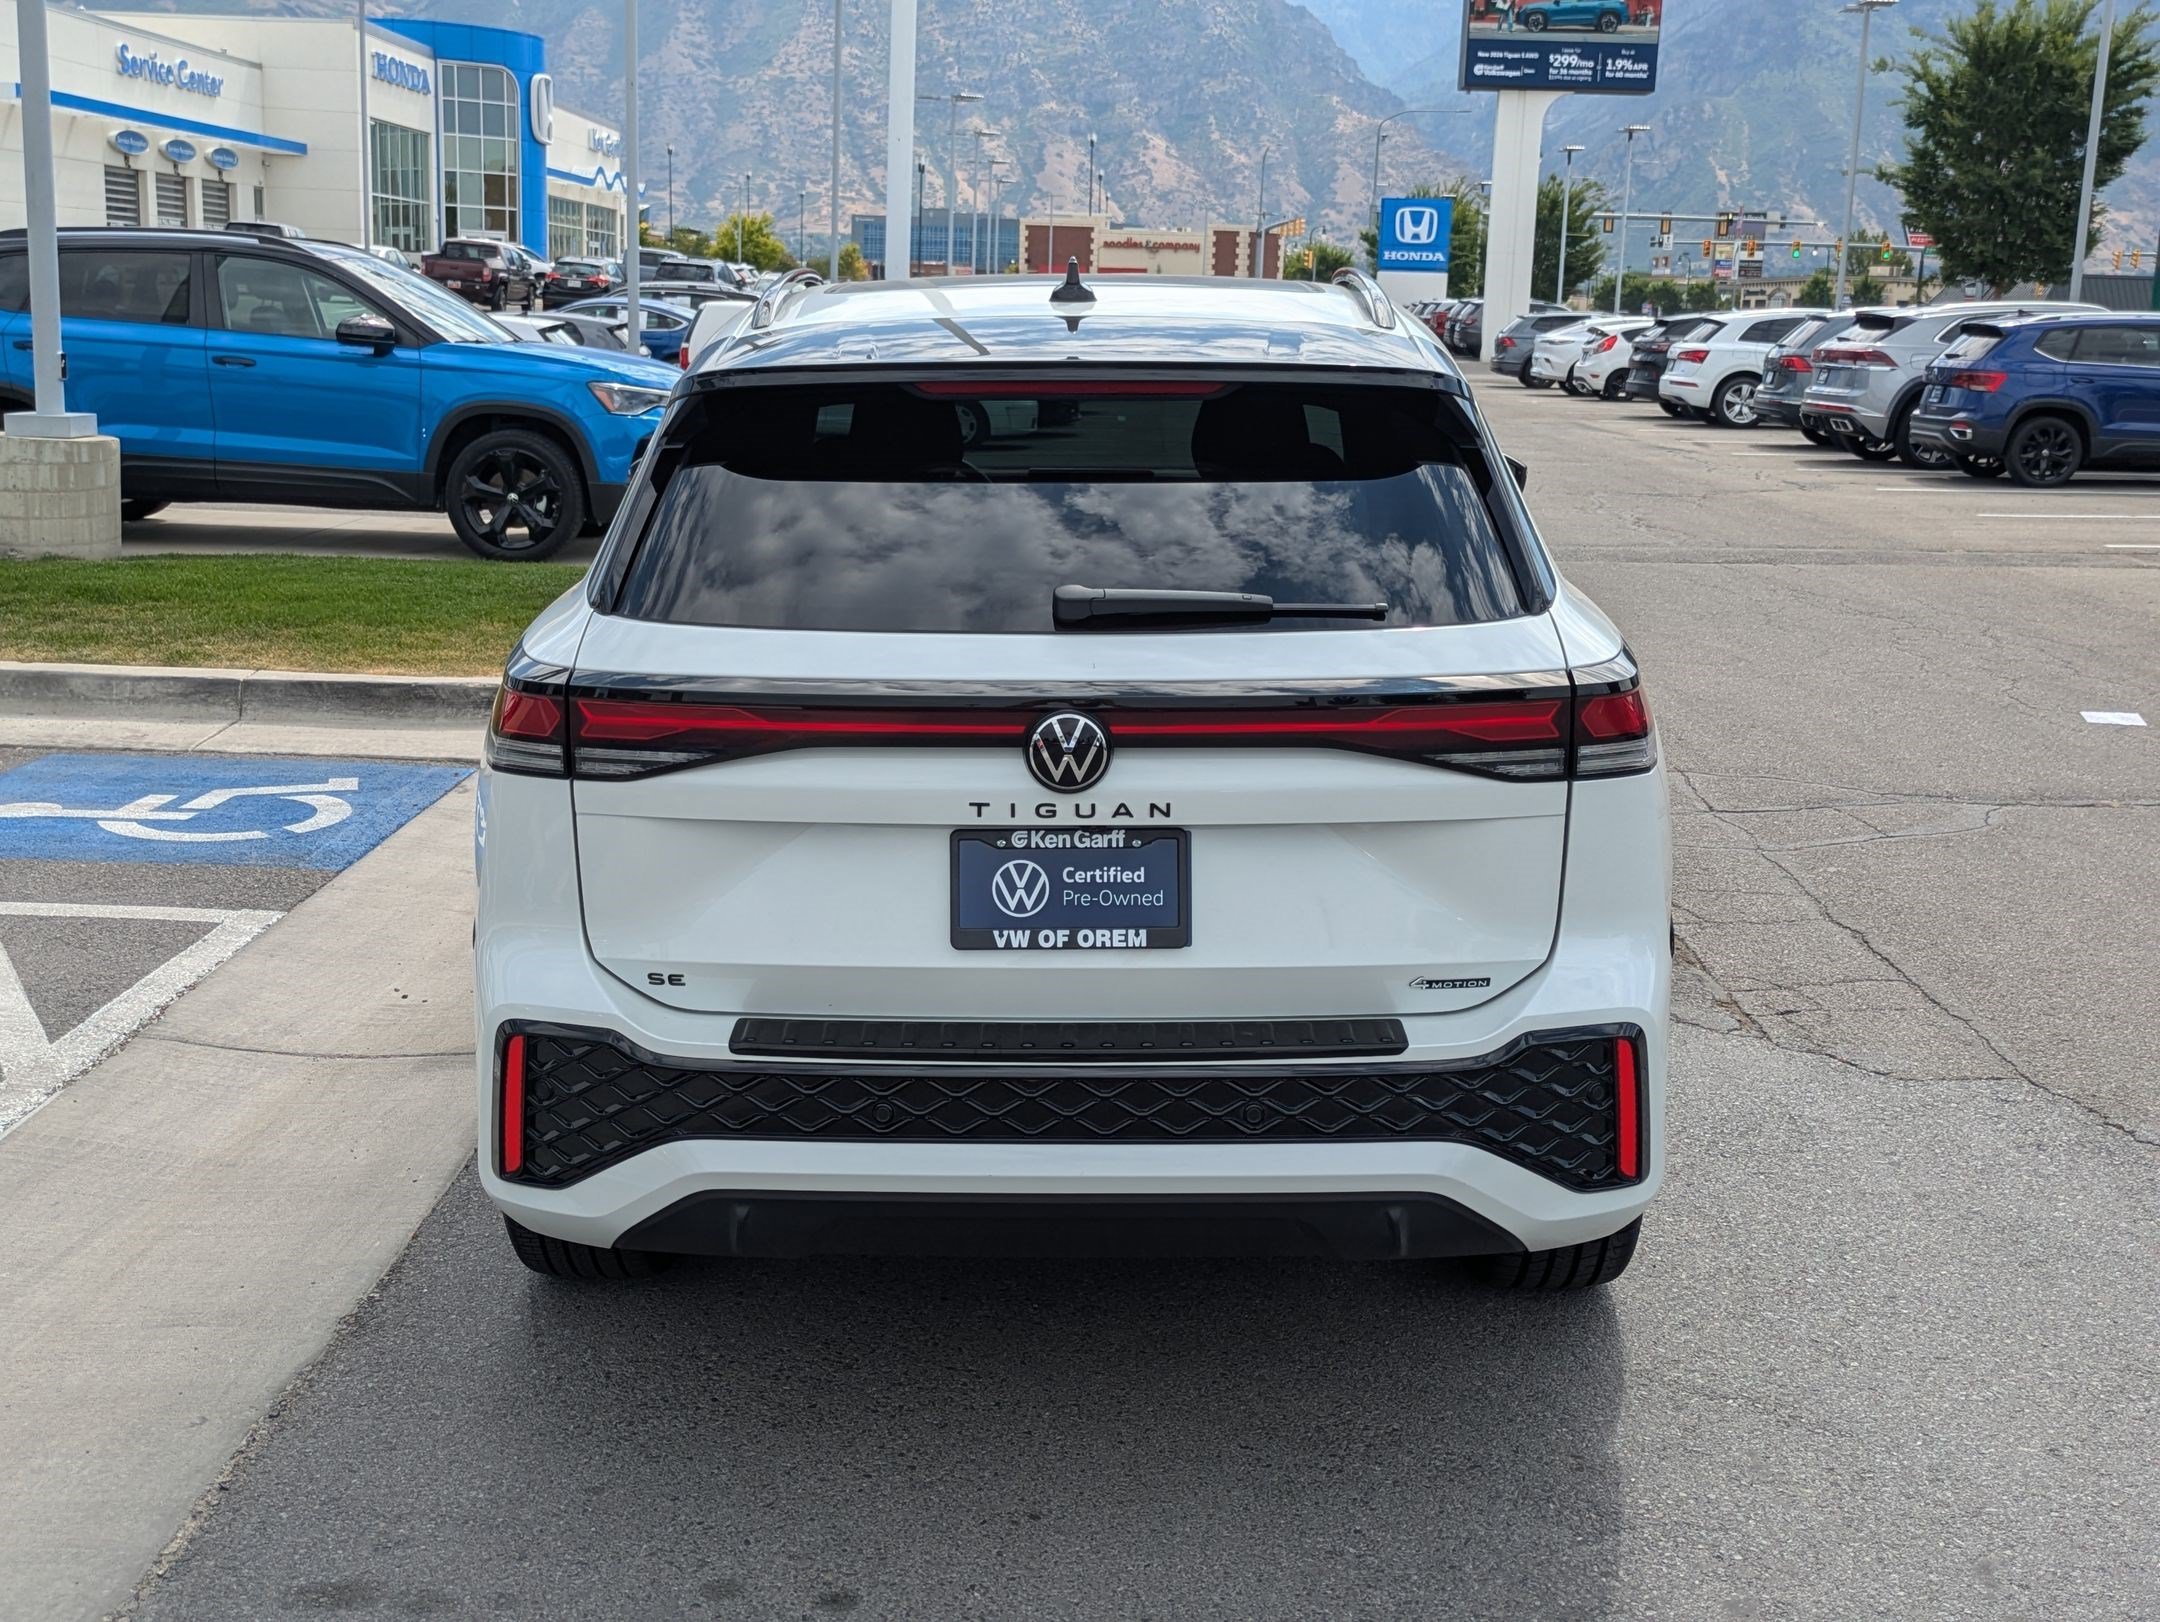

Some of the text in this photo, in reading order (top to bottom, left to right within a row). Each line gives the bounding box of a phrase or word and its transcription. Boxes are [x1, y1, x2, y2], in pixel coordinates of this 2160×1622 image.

[1549, 53, 1595, 68] $299/mo
[116, 43, 224, 97] Service Center
[372, 52, 431, 95] HONDA
[1103, 237, 1143, 249] noodles
[1152, 240, 1200, 254] company
[1383, 251, 1446, 262] HONDA
[968, 802, 1171, 819] TIGUAN
[1031, 830, 1126, 849] Ken Garff
[1062, 866, 1145, 884] Certified
[1063, 889, 1164, 907] Pre-Owned
[992, 929, 1147, 948] VW OF OREM
[647, 972, 686, 987] SE
[1409, 976, 1489, 990] 4MOTION
